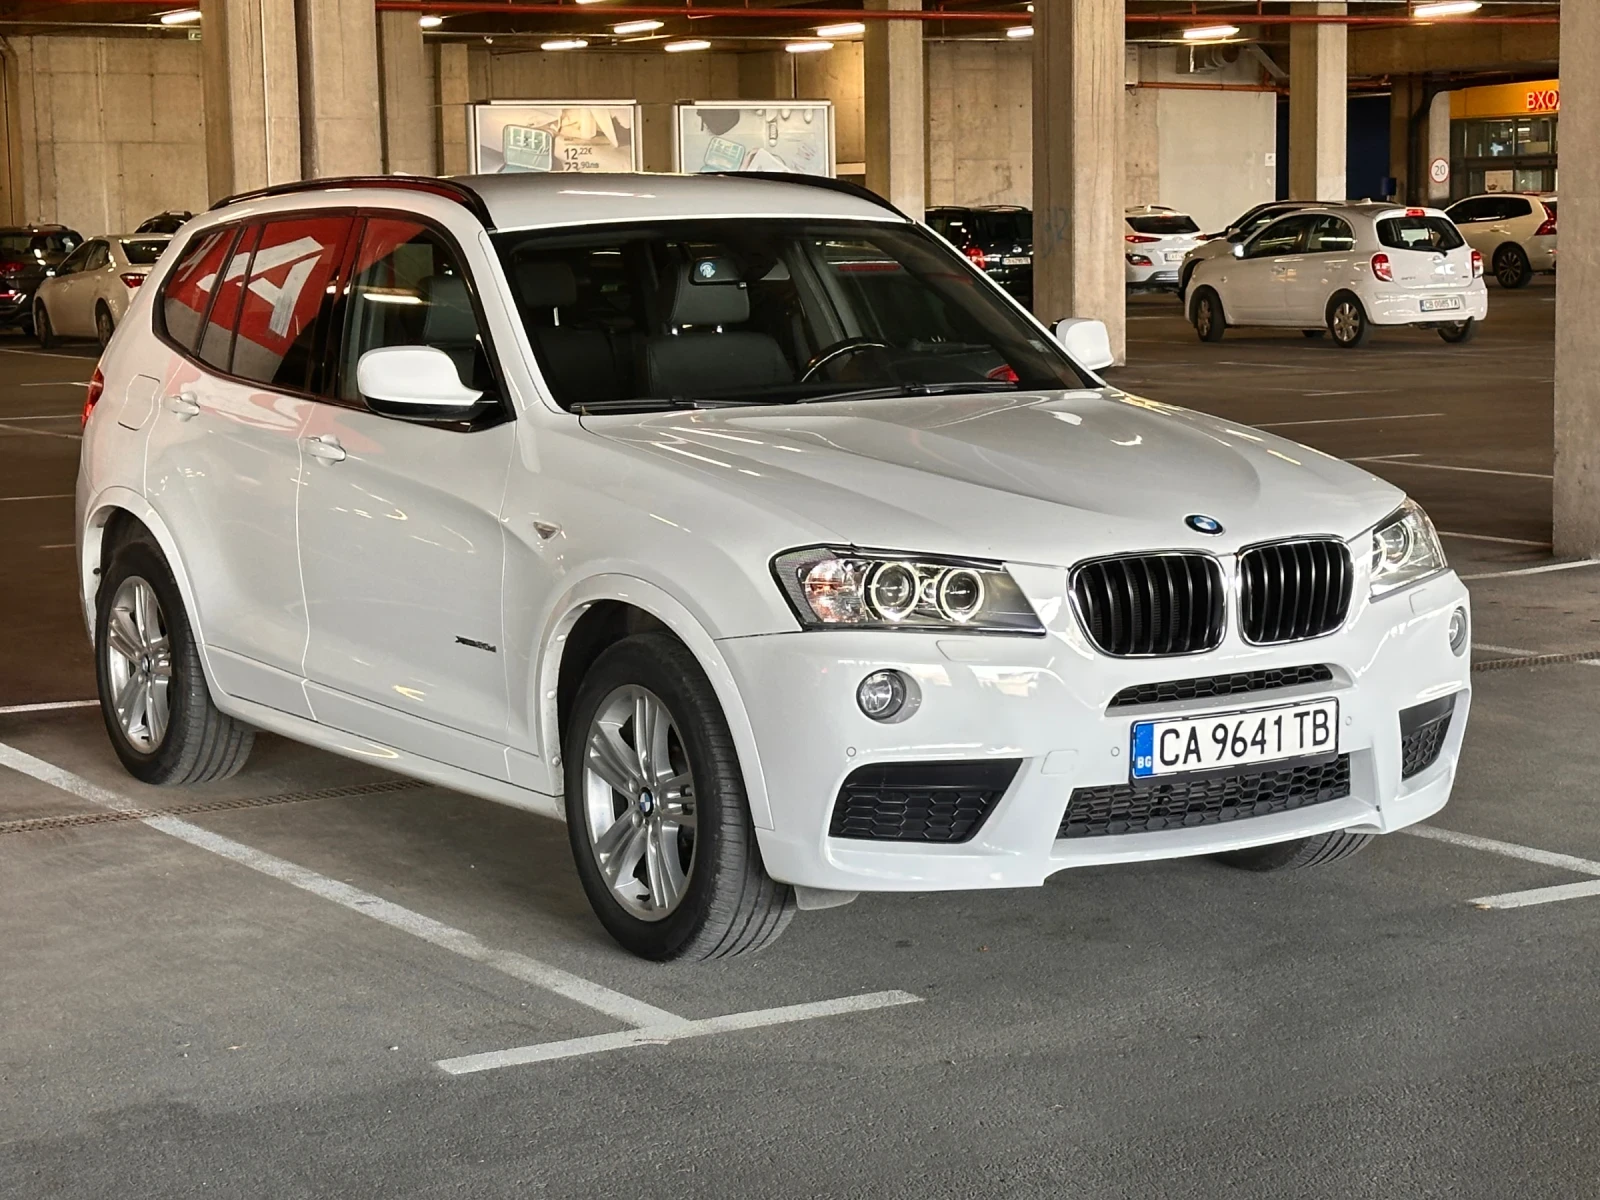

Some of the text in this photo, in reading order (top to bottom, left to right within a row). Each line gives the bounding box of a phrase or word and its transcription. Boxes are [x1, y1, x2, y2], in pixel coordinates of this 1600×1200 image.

[1526, 90, 1560, 110] ВХО
[1434, 165, 1446, 176] 20
[1160, 709, 1330, 766] CA 9641 TB
[1137, 756, 1152, 769] BG
